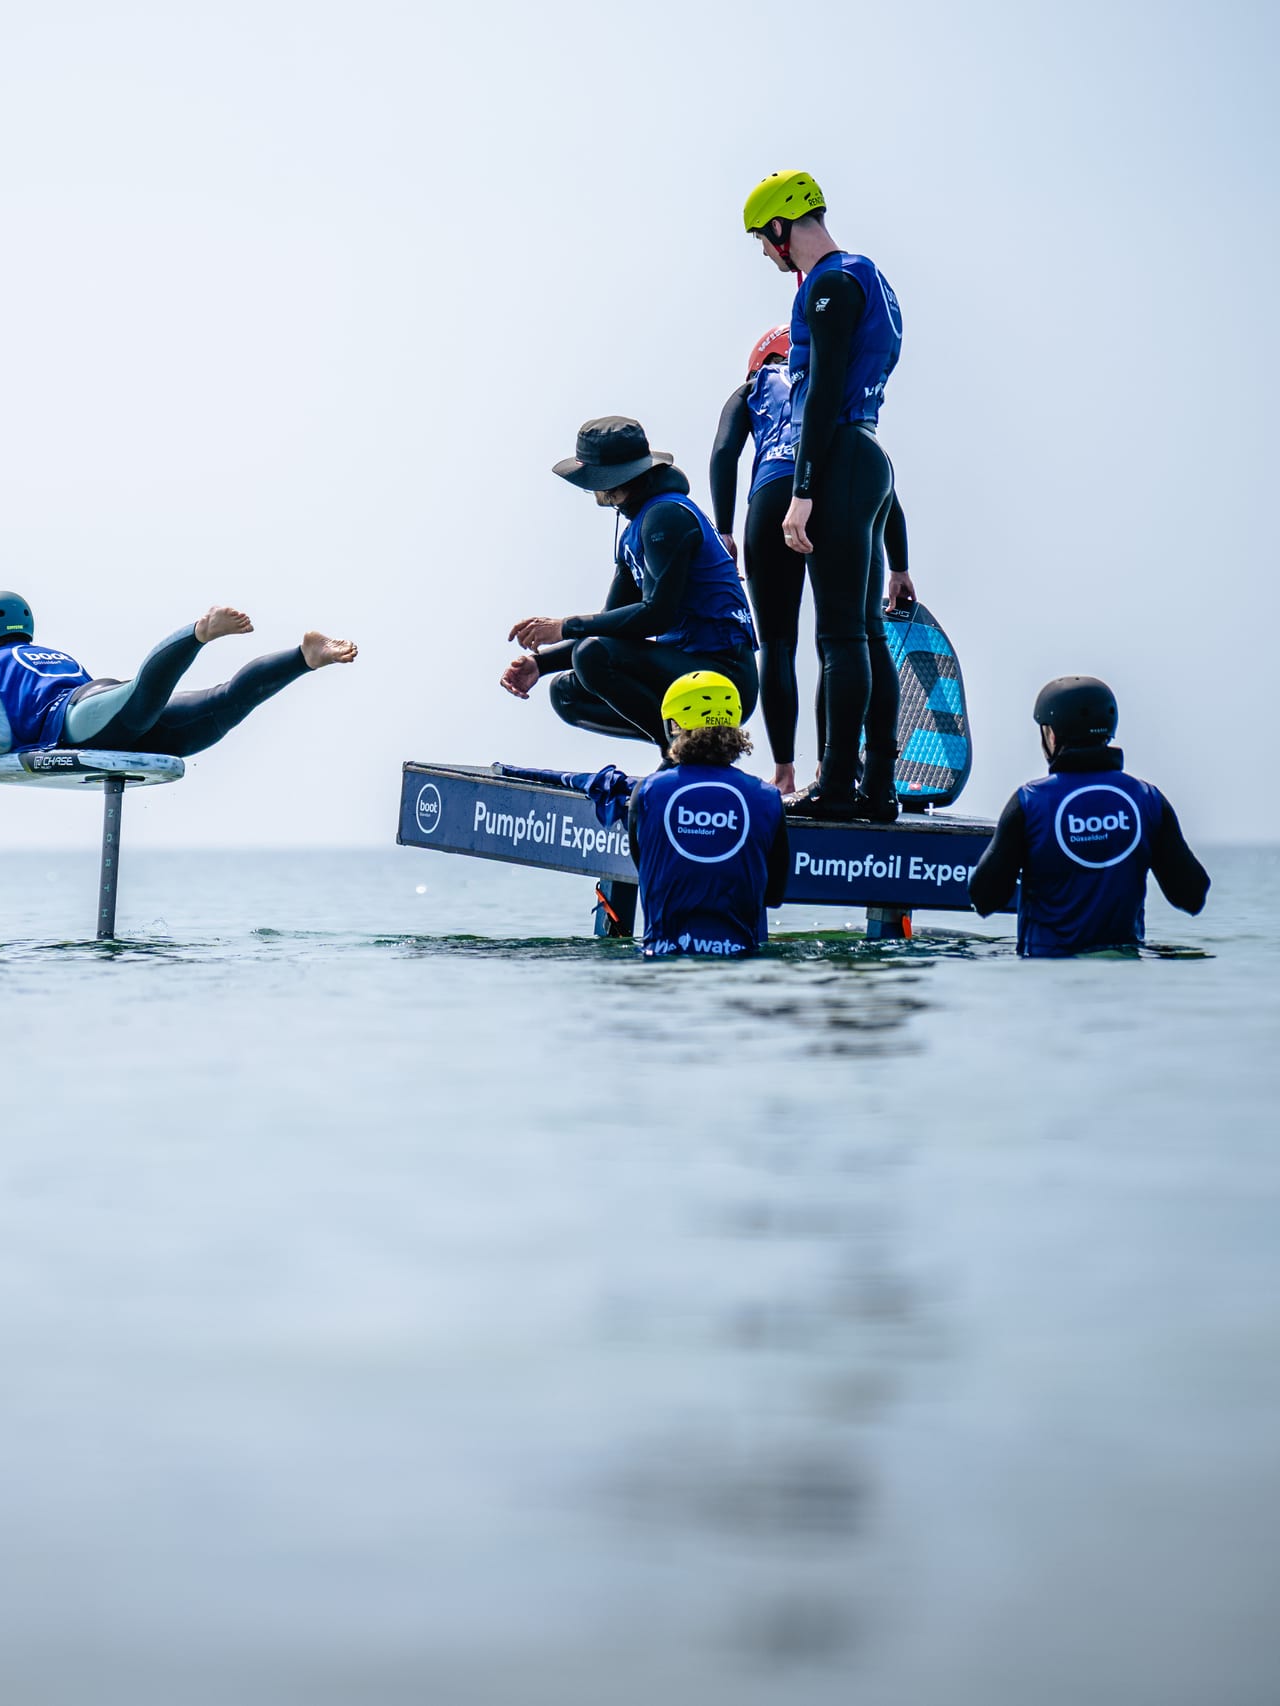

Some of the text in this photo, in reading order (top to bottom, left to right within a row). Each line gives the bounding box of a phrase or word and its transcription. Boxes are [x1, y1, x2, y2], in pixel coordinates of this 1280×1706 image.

[705, 716, 731, 725] RENTAL
[43, 756, 74, 766] CHASE
[420, 799, 438, 814] boot
[678, 806, 738, 830] boot
[1068, 810, 1130, 833] boot
[474, 801, 630, 858] Pumpfoil Experie
[677, 826, 716, 836] Düsseldorf
[794, 852, 902, 882] Pumpfoil
